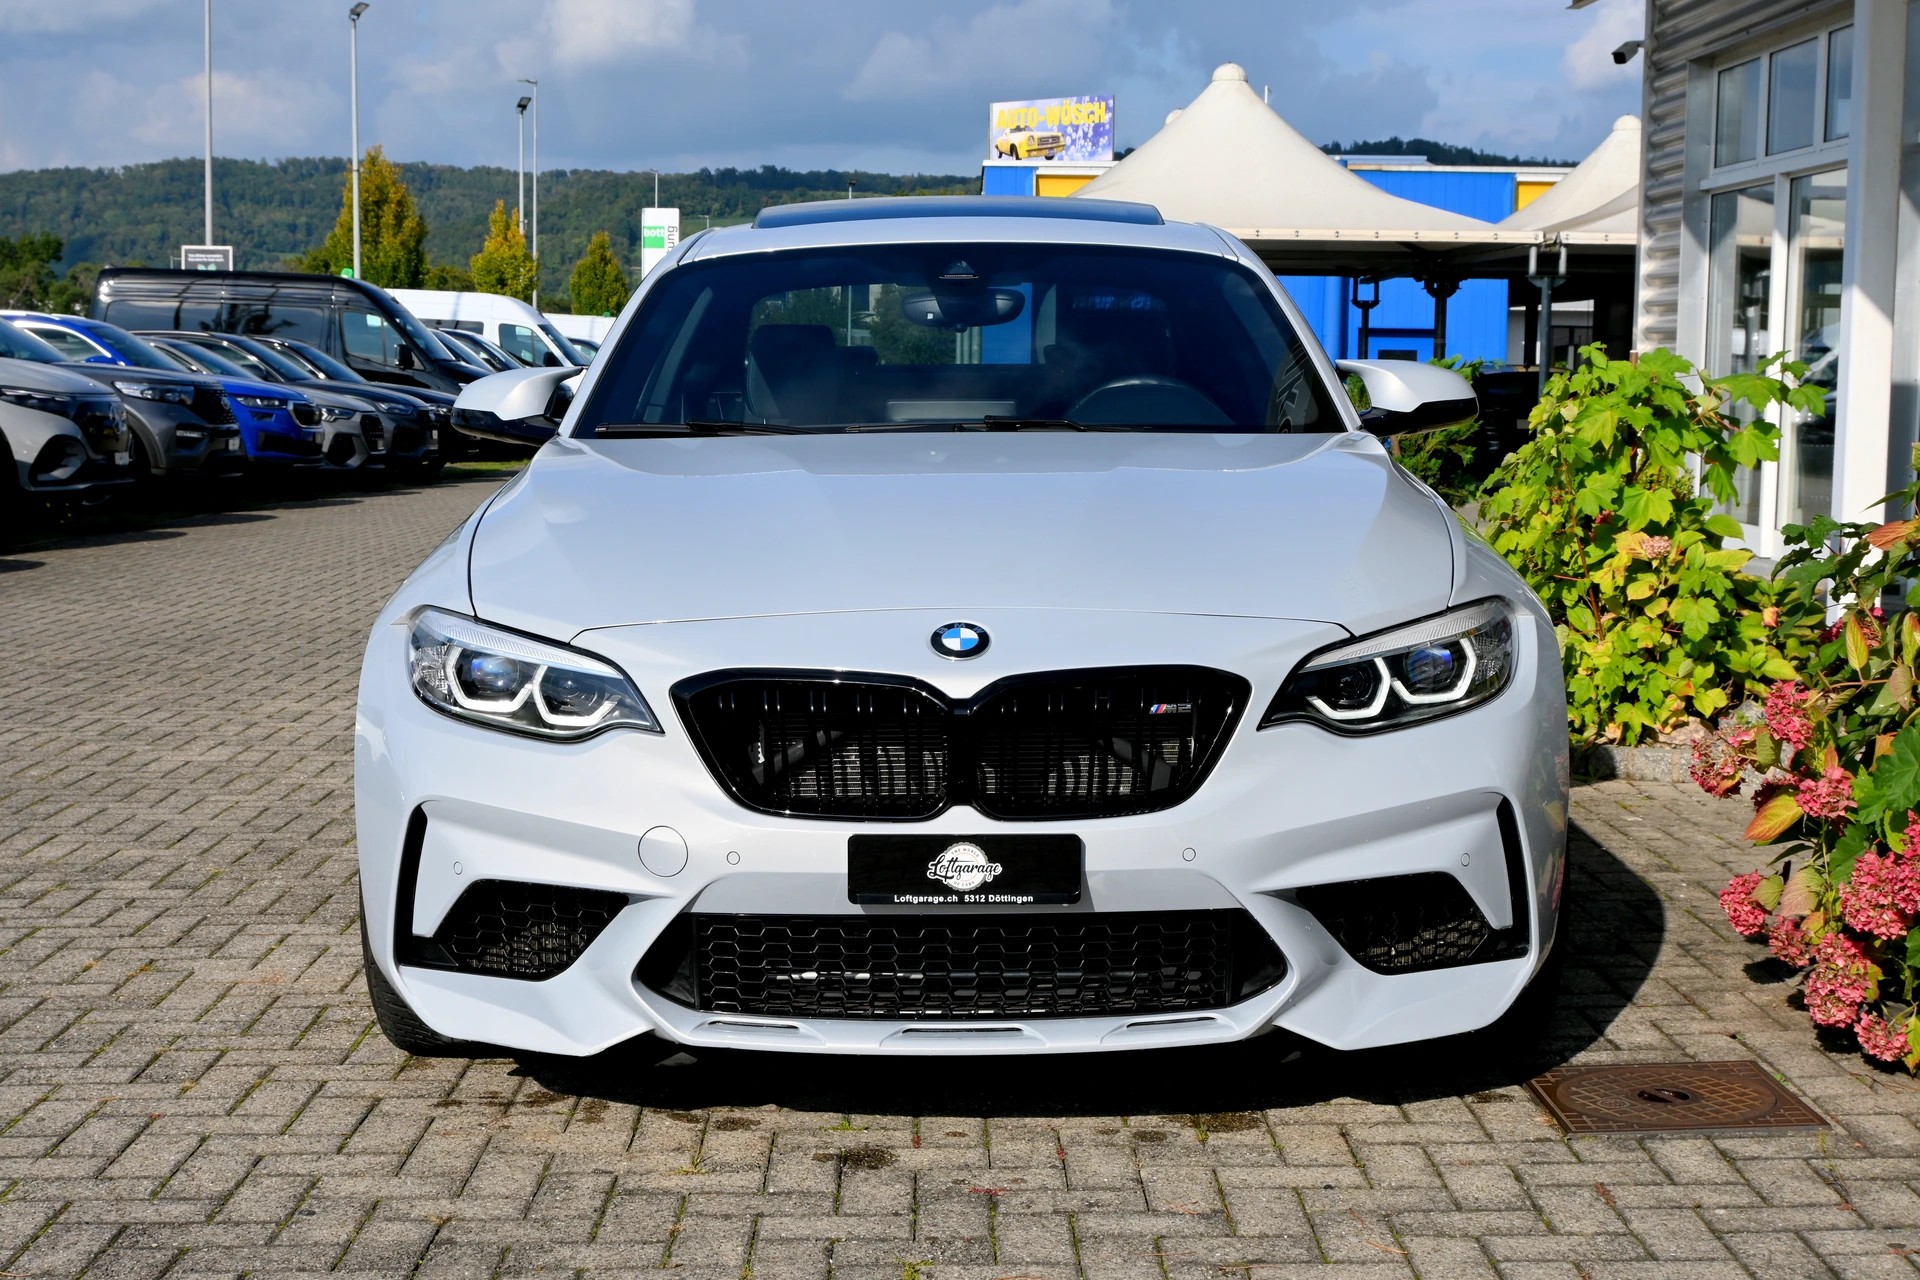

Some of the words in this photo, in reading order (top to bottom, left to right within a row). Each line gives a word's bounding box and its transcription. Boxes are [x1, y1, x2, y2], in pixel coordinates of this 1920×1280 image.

[996, 99, 1107, 130] AUTO-WÖSCH
[643, 227, 666, 238] bott
[928, 854, 1000, 883] Loftgarage
[894, 894, 958, 904] Loftgarage.ch
[964, 894, 986, 903] 5312
[988, 894, 1034, 904] Döttingen
